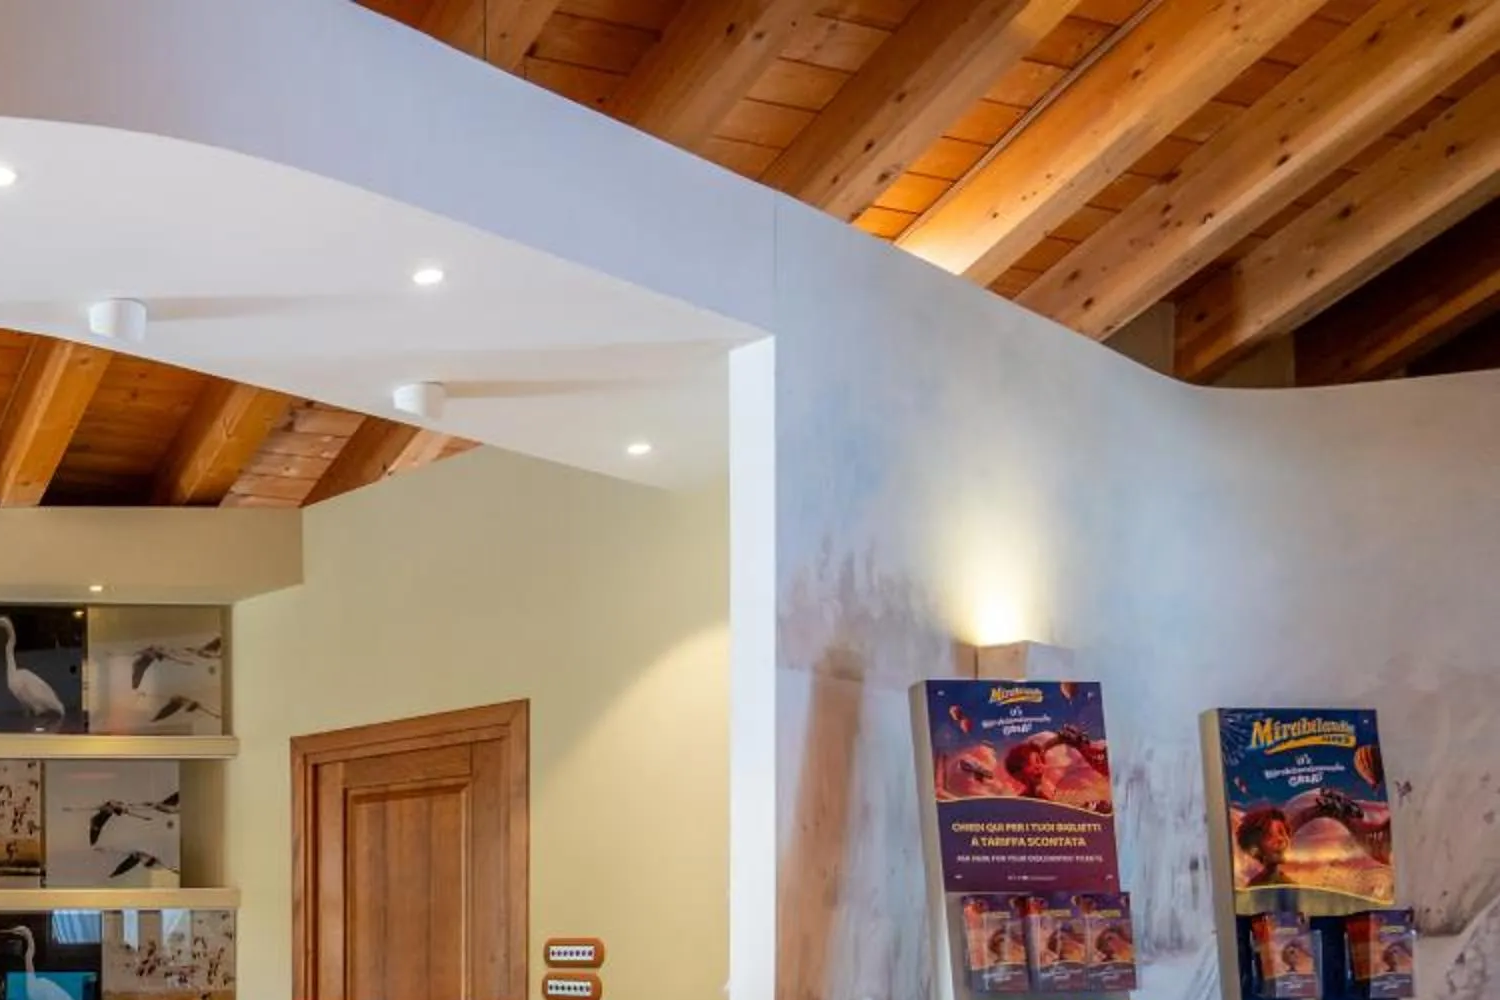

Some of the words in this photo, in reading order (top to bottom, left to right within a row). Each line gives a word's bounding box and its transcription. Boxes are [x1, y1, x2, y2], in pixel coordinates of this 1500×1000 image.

[952, 823, 985, 833] CHIEDI
[986, 823, 1005, 833] QUI
[1006, 823, 1025, 833] PER
[1030, 823, 1054, 833] TUOI
[1056, 823, 1101, 833] BIGLIETTI
[971, 837, 980, 847] A
[980, 837, 1026, 847] TARIFFA
[1027, 837, 1087, 847] SCONTATA
